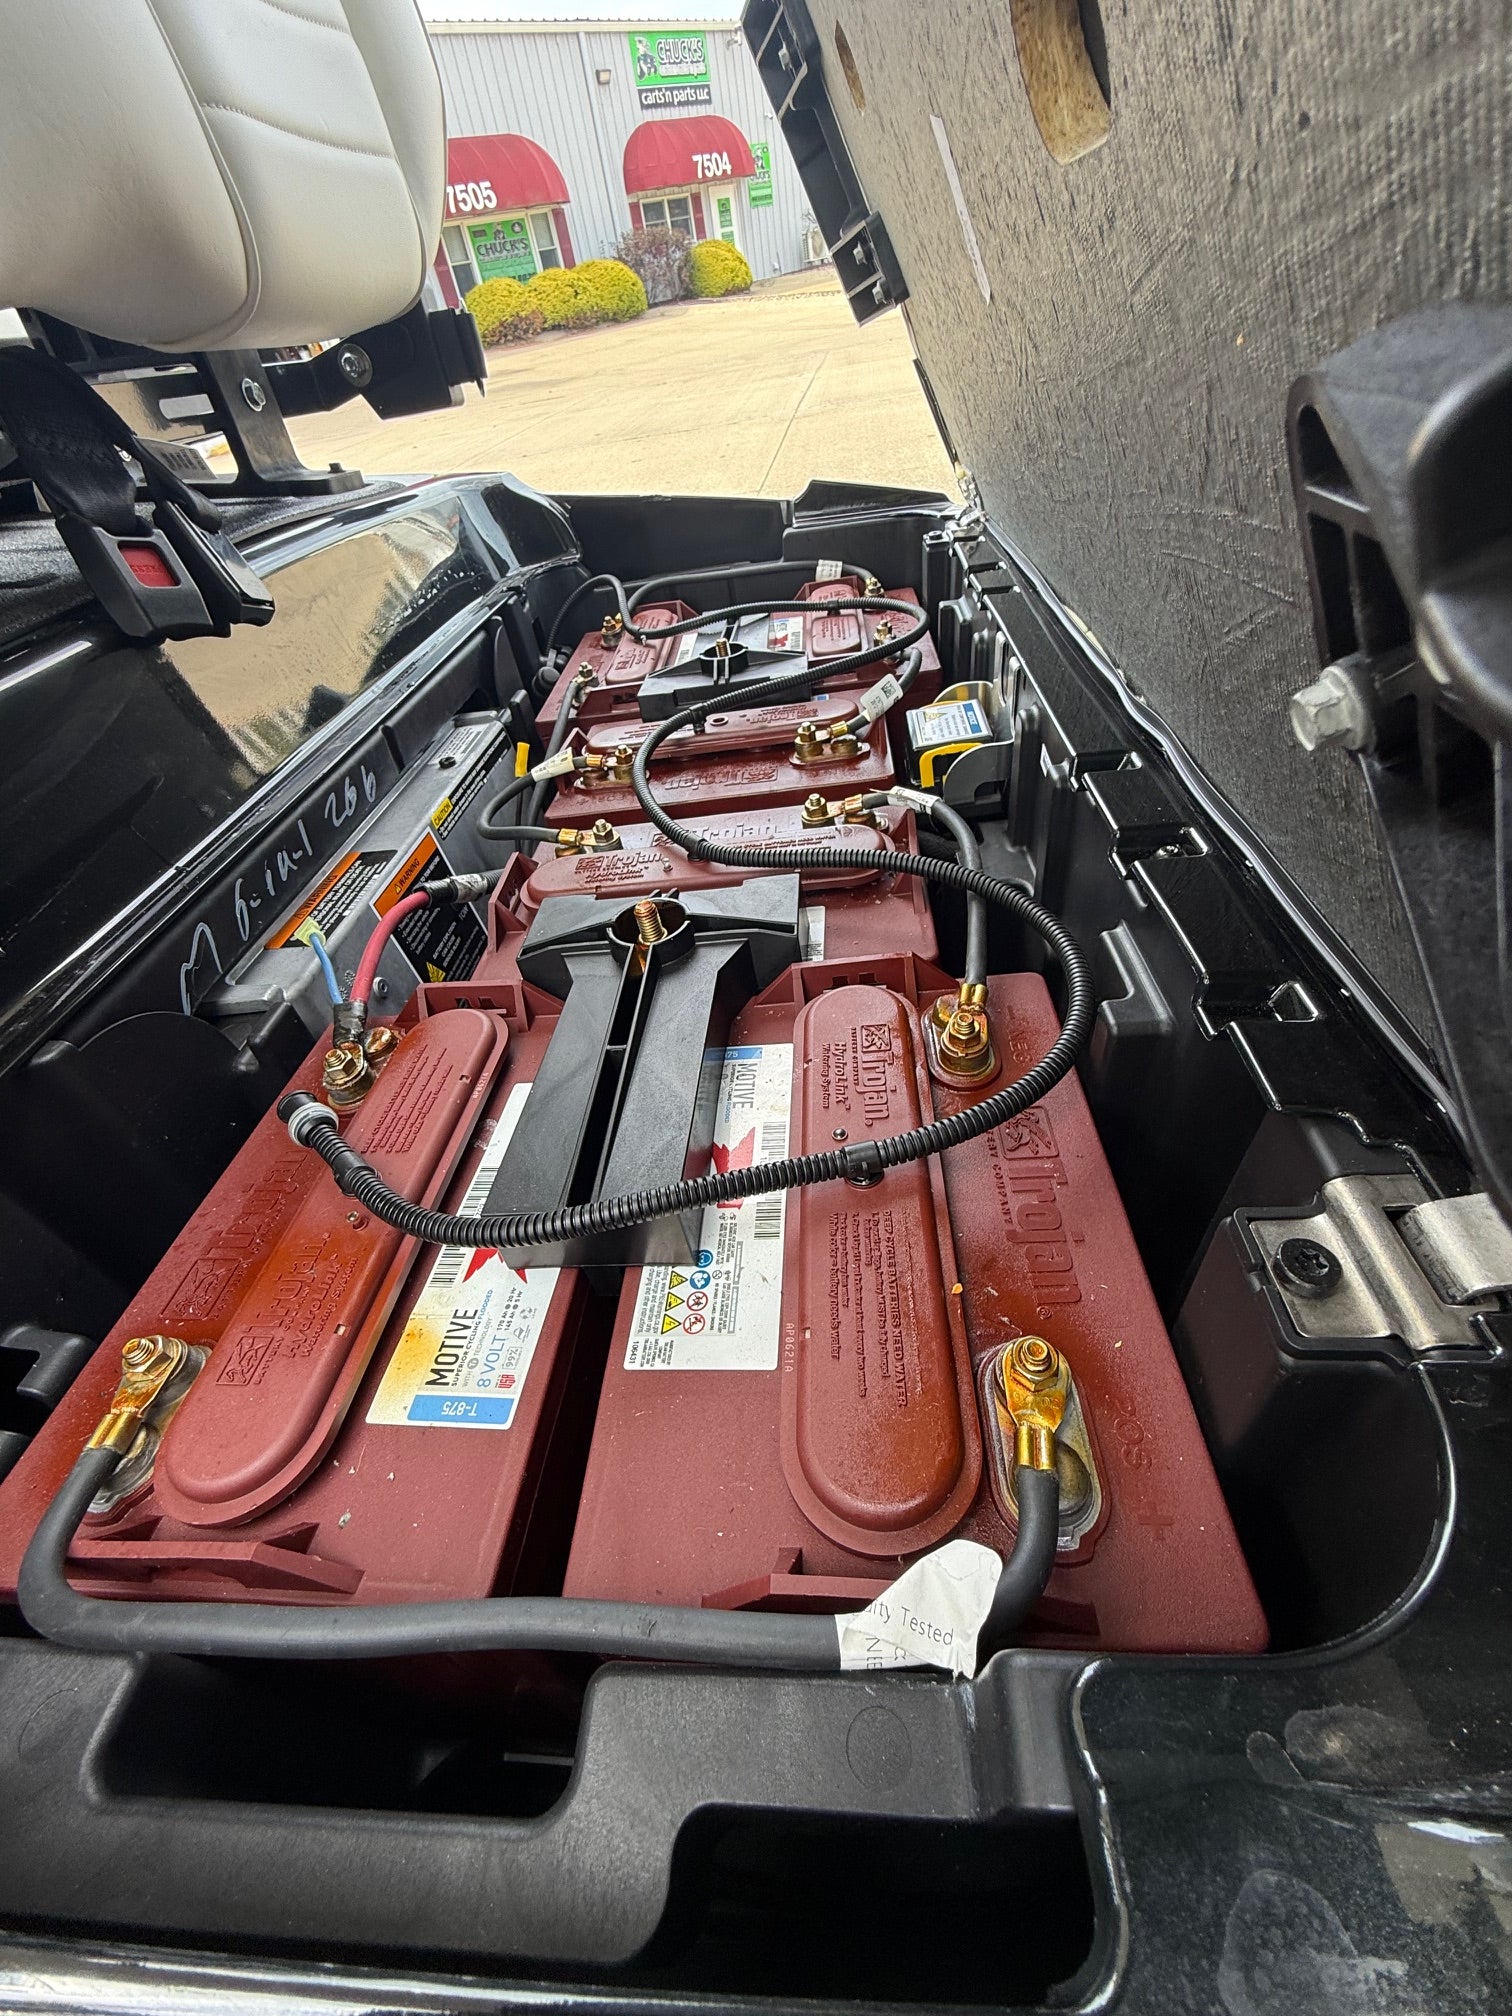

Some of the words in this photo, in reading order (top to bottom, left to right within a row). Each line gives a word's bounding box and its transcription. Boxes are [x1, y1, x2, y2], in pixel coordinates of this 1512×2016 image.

[672, 87, 696, 105] parts
[692, 151, 732, 178] 7504
[433, 802, 451, 826] CAUTION
[397, 858, 420, 887] WARNING
[604, 852, 662, 873] Trojan
[303, 875, 337, 907] WARNING
[733, 1062, 757, 1108] MOTIVE
[856, 1050, 896, 1120] Trojan
[881, 1210, 892, 1233] DEEP
[1005, 1158, 1085, 1304] Trojan
[883, 1235, 894, 1266] CYCLE
[829, 1267, 839, 1297] battery
[886, 1268, 901, 1327] BATTERIES
[828, 1298, 839, 1329] needs
[876, 1295, 885, 1318] MUST
[424, 1309, 478, 1384] MOTIVE
[451, 1351, 469, 1385] SUPERIOR
[466, 1321, 481, 1348] CYCLING
[477, 1290, 493, 1318] FLOODED
[473, 1316, 492, 1355] TECHNOLOGY
[784, 1322, 794, 1371] AP0621A
[829, 1330, 839, 1361] water
[892, 1329, 903, 1359] NEED
[480, 1334, 507, 1373] VOLT
[476, 1378, 492, 1389] 8
[498, 1373, 515, 1388] USA
[441, 1401, 477, 1416] T-875
[901, 1606, 955, 1646] Tested
